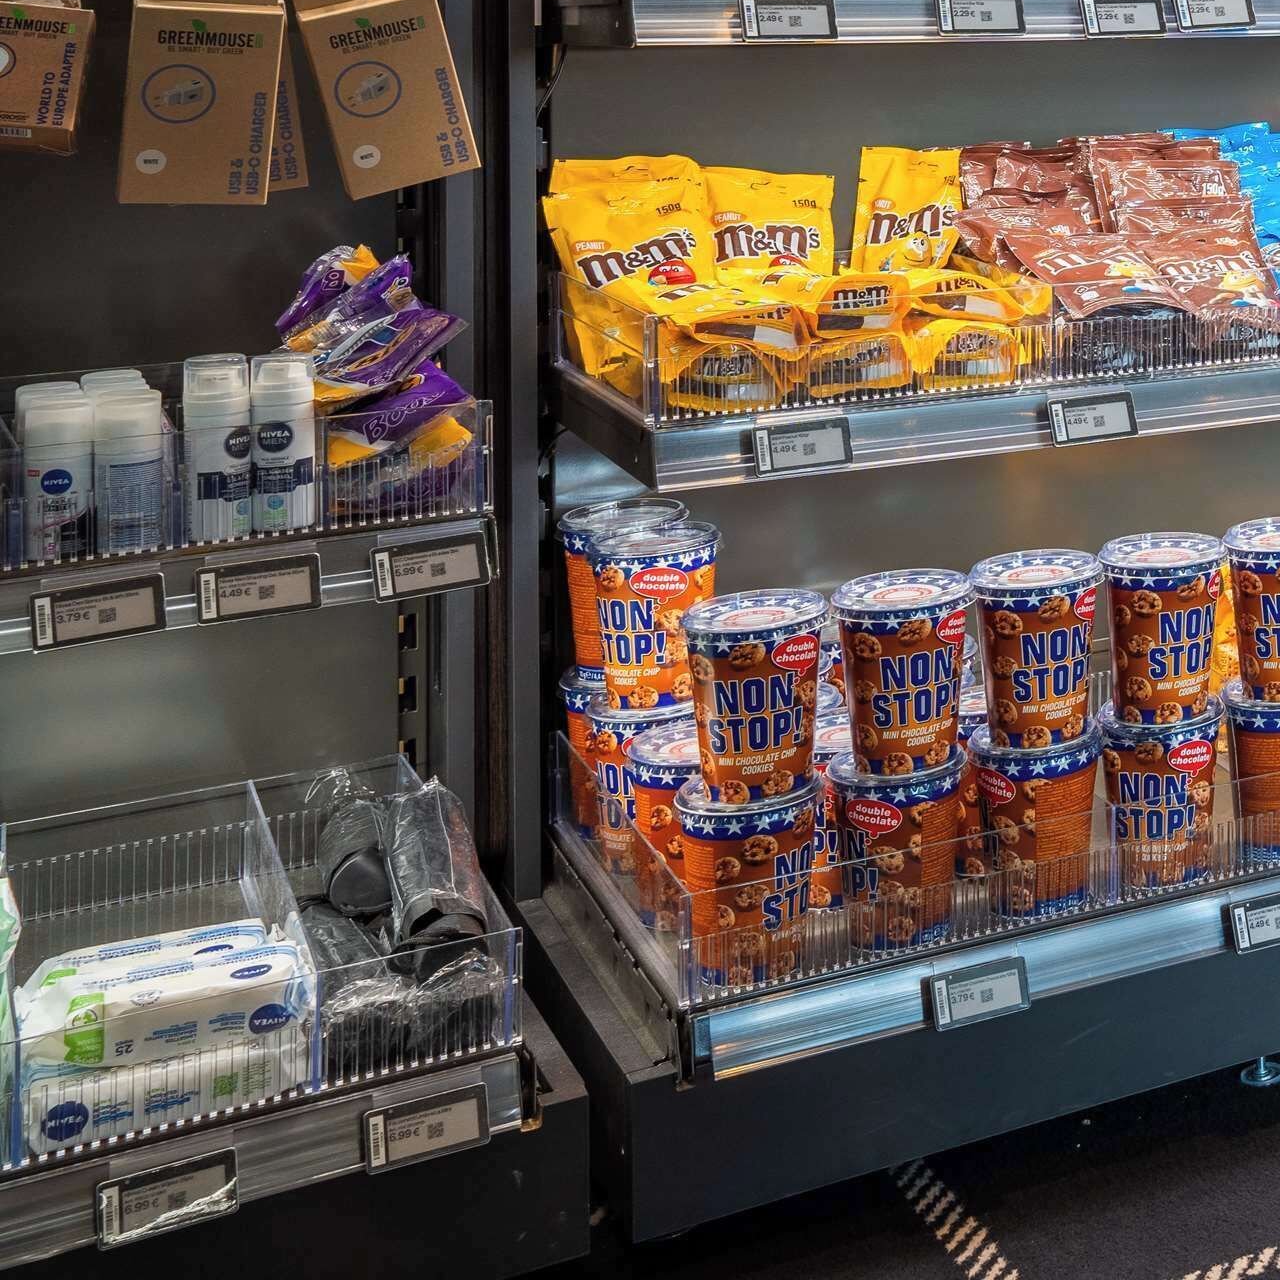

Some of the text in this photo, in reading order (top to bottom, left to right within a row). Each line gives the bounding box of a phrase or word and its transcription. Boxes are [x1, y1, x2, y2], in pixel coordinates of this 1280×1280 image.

[759, 14, 783, 23] 2.49 €
[953, 8, 976, 18] 2.29 €
[1098, 12, 1119, 21] 2.29 €
[157, 29, 256, 48] GREENMOUSE
[328, 17, 418, 49] GREENMOUSE
[52, 41, 78, 127] EUROPE ADAPTER
[36, 71, 56, 125] WORLD TO
[434, 66, 470, 163] USB-C CHARGER
[245, 91, 267, 195] USB-C CHARGER
[1201, 183, 1226, 196] 150g
[656, 201, 682, 216] 150g
[792, 198, 817, 208] 150g
[714, 212, 742, 222] PEANUT
[575, 240, 605, 252] PEANUT
[713, 223, 821, 266] m&m's
[577, 228, 697, 289] m&m's
[1067, 416, 1089, 426] 4.49 €
[260, 429, 291, 439] NIVEA
[262, 436, 288, 446] MEN
[772, 443, 798, 455] 4.49 €
[43, 477, 70, 486] NIVEA
[395, 565, 425, 578] 5.99 €
[642, 572, 680, 583] double
[633, 580, 686, 591] chocolate
[220, 586, 252, 599] 4.49 €
[56, 610, 91, 625] 3.79 €
[597, 596, 655, 634] NON
[1158, 602, 1216, 646] NON
[785, 640, 815, 652] double
[1019, 620, 1090, 668] NON
[775, 650, 818, 663] chocolate
[879, 645, 955, 693] NON
[1263, 660, 1277, 669] MINI
[614, 677, 638, 686] COOKIES
[711, 670, 798, 718] NON
[1178, 684, 1200, 697] COOKIES
[871, 679, 959, 730] STOP!
[1045, 708, 1073, 721] COOKIES
[709, 705, 804, 757] STOP!
[882, 730, 899, 740] MINI
[900, 723, 942, 738] CHOCOLATE
[906, 734, 936, 748] COOKIES
[718, 746, 797, 767] MINI CHOCOLATE CHIP
[1180, 745, 1208, 757] double
[1170, 752, 1211, 766] chocolate
[741, 762, 775, 776] COOKIES
[1119, 772, 1189, 808] NON
[854, 802, 892, 818] double
[848, 810, 899, 827] chocolate
[1116, 800, 1196, 841] STOP!
[1250, 918, 1271, 930] 4.49 €
[235, 966, 268, 978] NIVEA
[951, 992, 976, 1005] 3.79 €
[252, 1015, 286, 1028] NIVEA
[115, 1044, 134, 1056] 25
[389, 1129, 421, 1143] 6.99 €
[124, 1197, 160, 1216] 6.99 €
